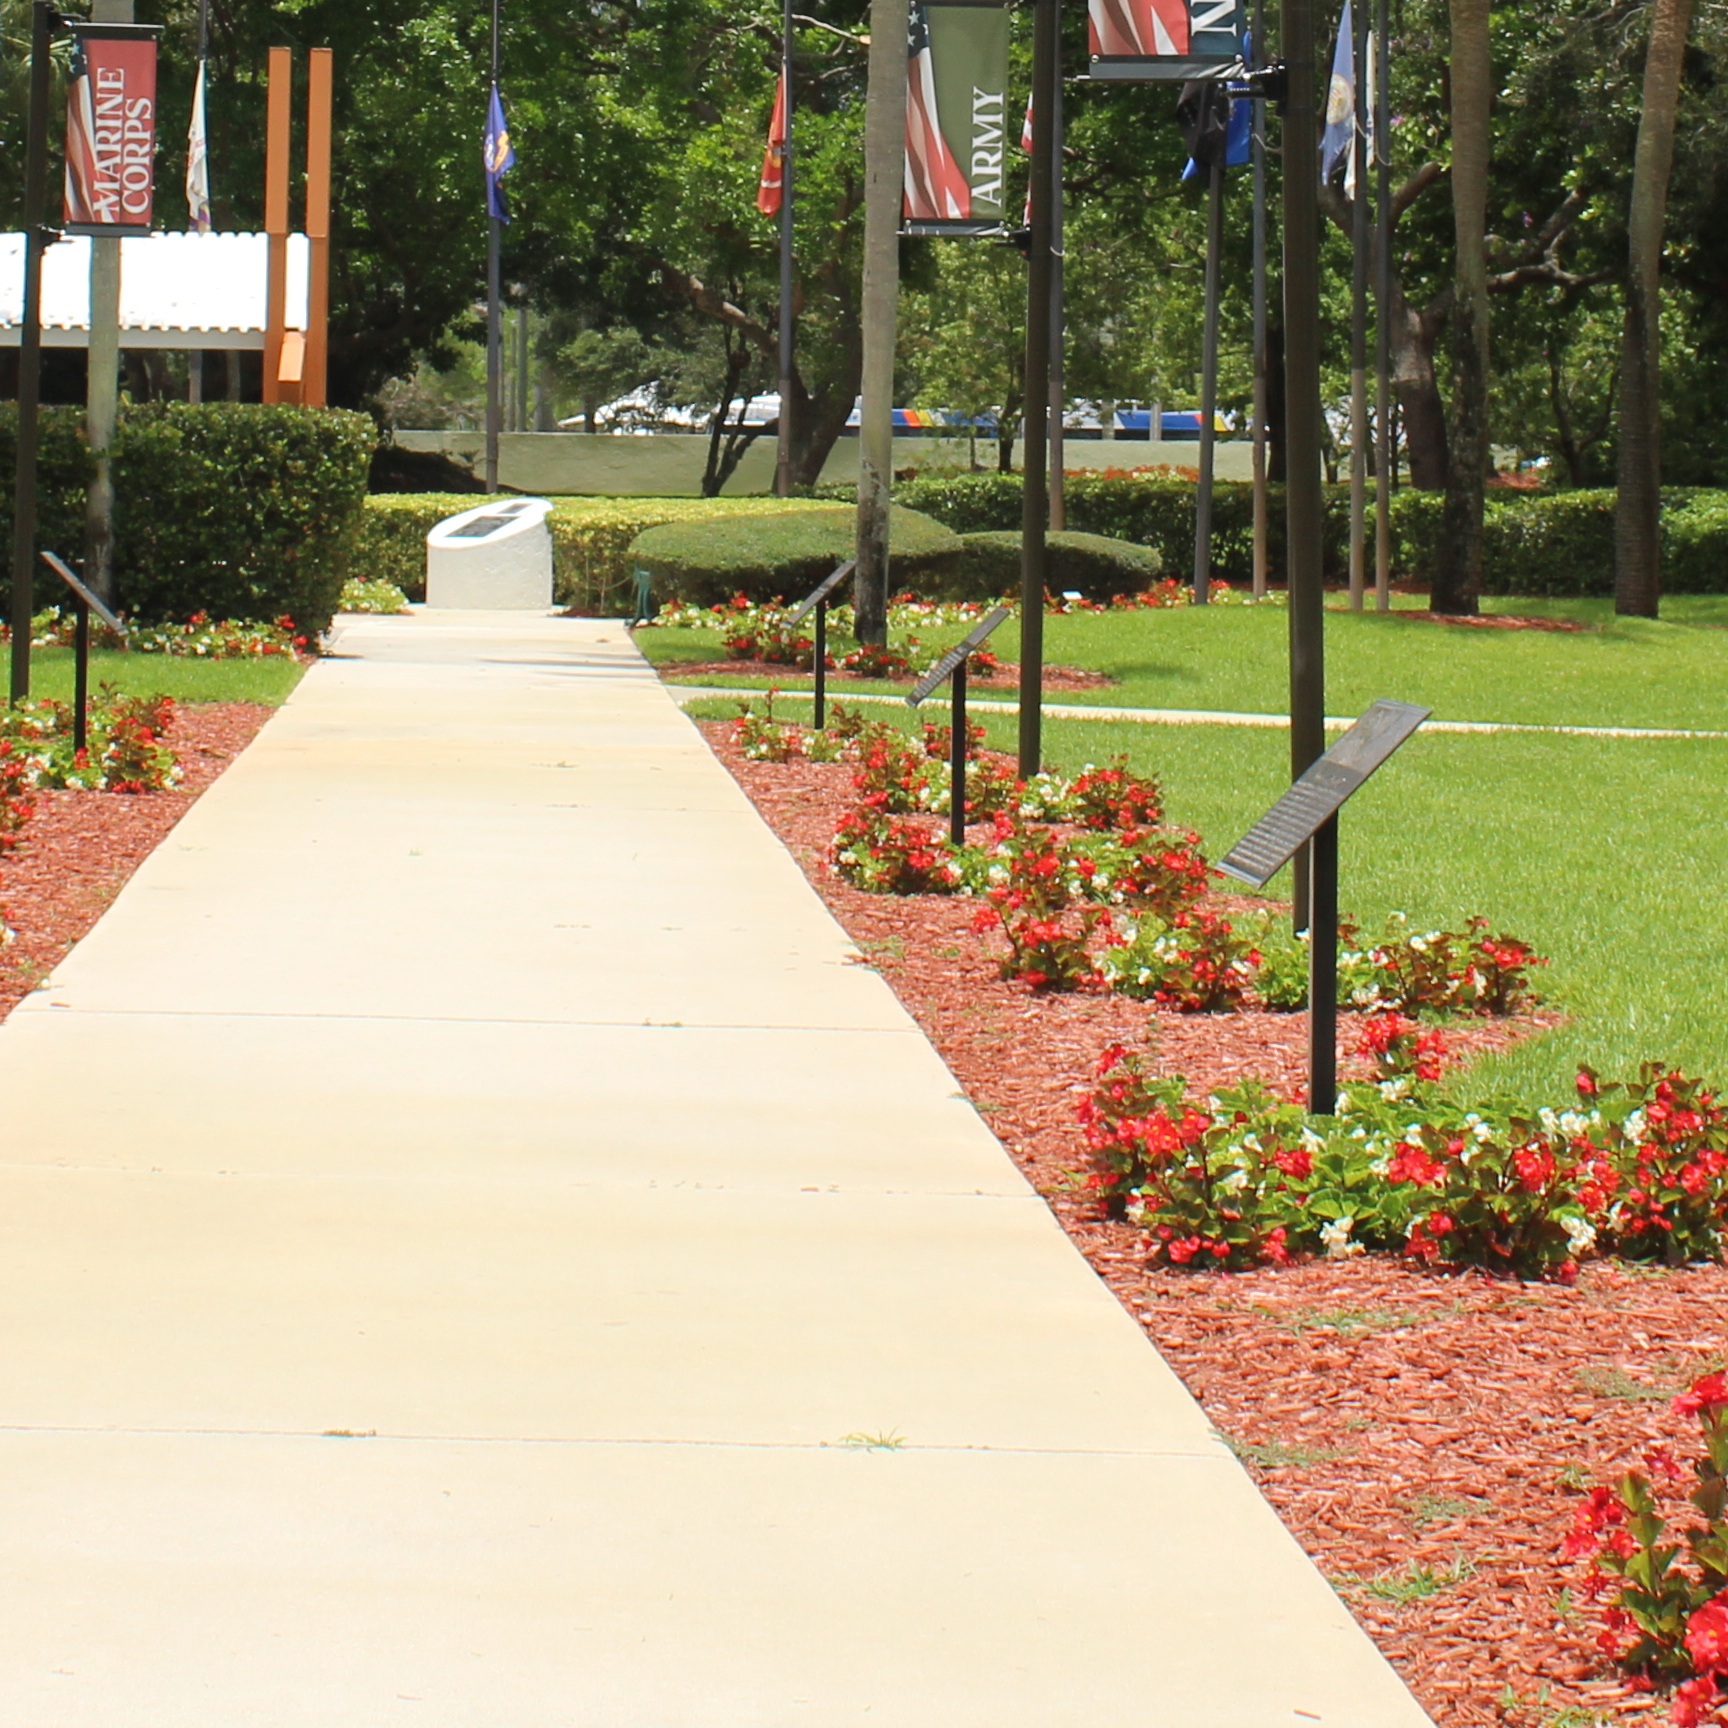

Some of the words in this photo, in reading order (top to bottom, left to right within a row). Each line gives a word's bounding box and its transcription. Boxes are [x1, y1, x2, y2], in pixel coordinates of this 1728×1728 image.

[93, 67, 125, 213] MARINE
[121, 97, 152, 215] CORPS
[971, 86, 1004, 208] ARMY
